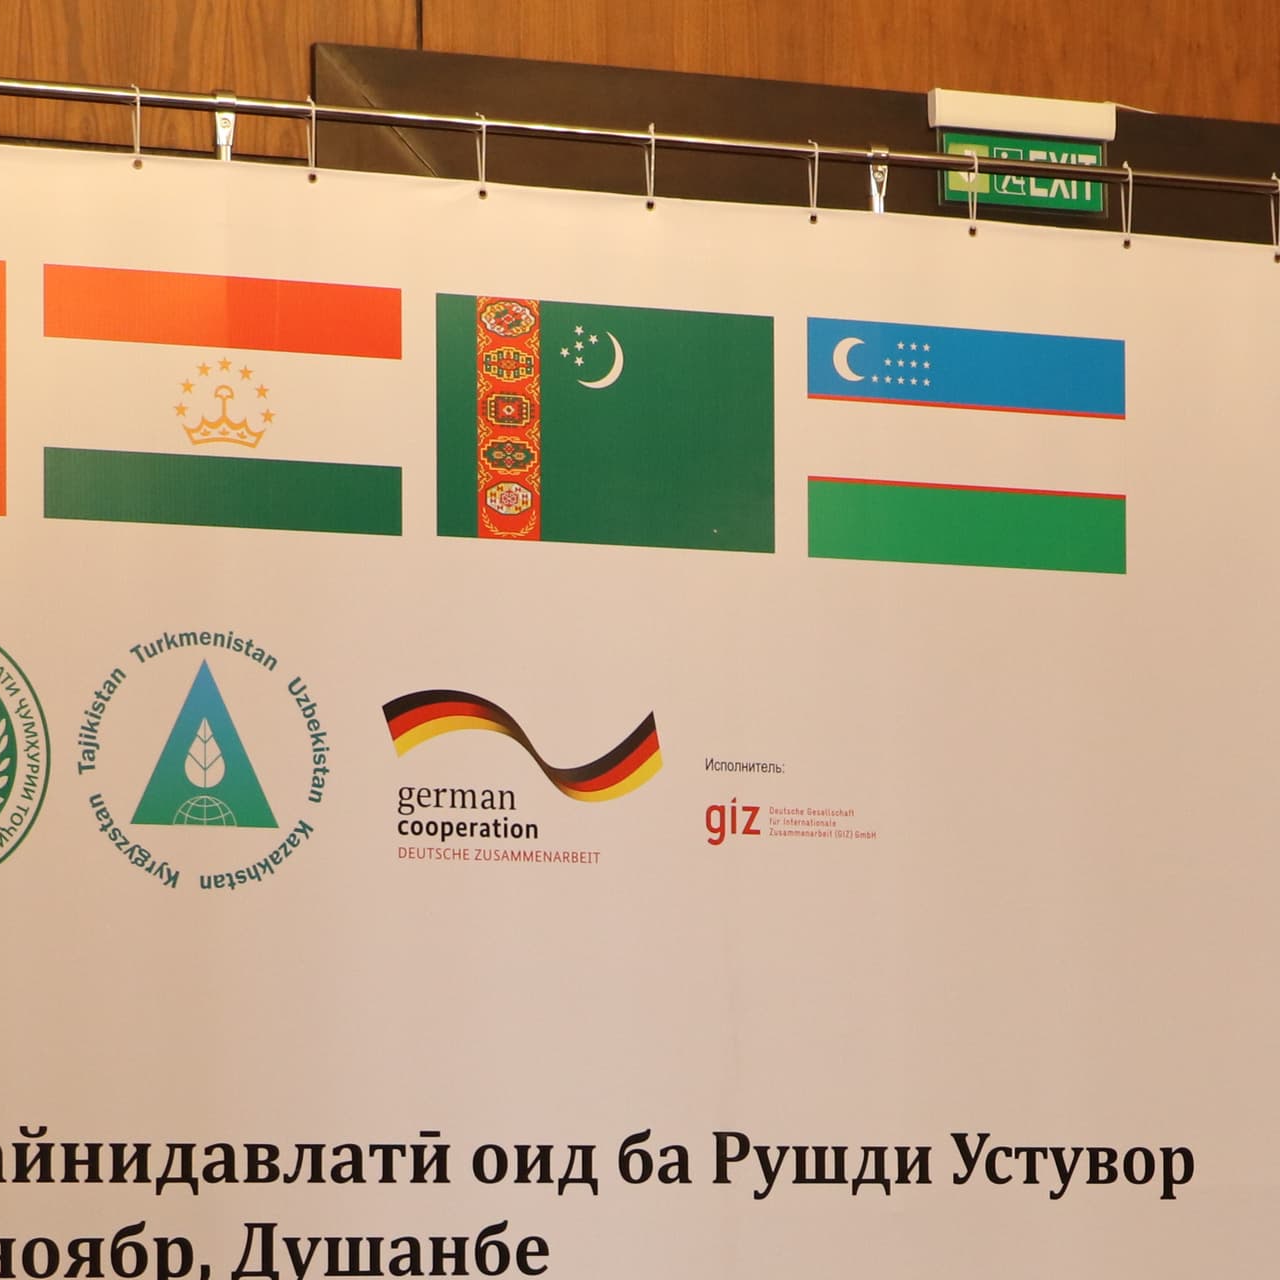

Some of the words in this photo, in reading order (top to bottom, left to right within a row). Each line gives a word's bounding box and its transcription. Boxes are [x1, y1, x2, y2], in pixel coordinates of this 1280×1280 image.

[1029, 150, 1096, 200] EXIT
[129, 631, 278, 671] Turkmenistan
[77, 667, 127, 775] Tajikistan
[287, 676, 330, 804] Uzbekistan
[705, 758, 785, 774] Исполнитель:
[398, 786, 516, 815] german
[769, 806, 805, 816] Deutsche
[807, 807, 855, 817] Gesellschaft
[89, 793, 180, 889] Kyrgyzstan
[398, 817, 539, 843] cooperation
[705, 796, 761, 846] giz
[769, 828, 832, 839] Zusammenarbeit
[855, 831, 877, 840] GmbH
[783, 818, 837, 828] Internationale
[199, 819, 314, 890] Kazakhstan
[398, 846, 470, 861] DEUTSCHE
[474, 848, 601, 865] ZUSAMMENARBEIT
[471, 1142, 599, 1196] оид
[618, 1128, 693, 1186] ба
[712, 1131, 933, 1201] Рушди
[950, 1132, 1195, 1201] Устувор
